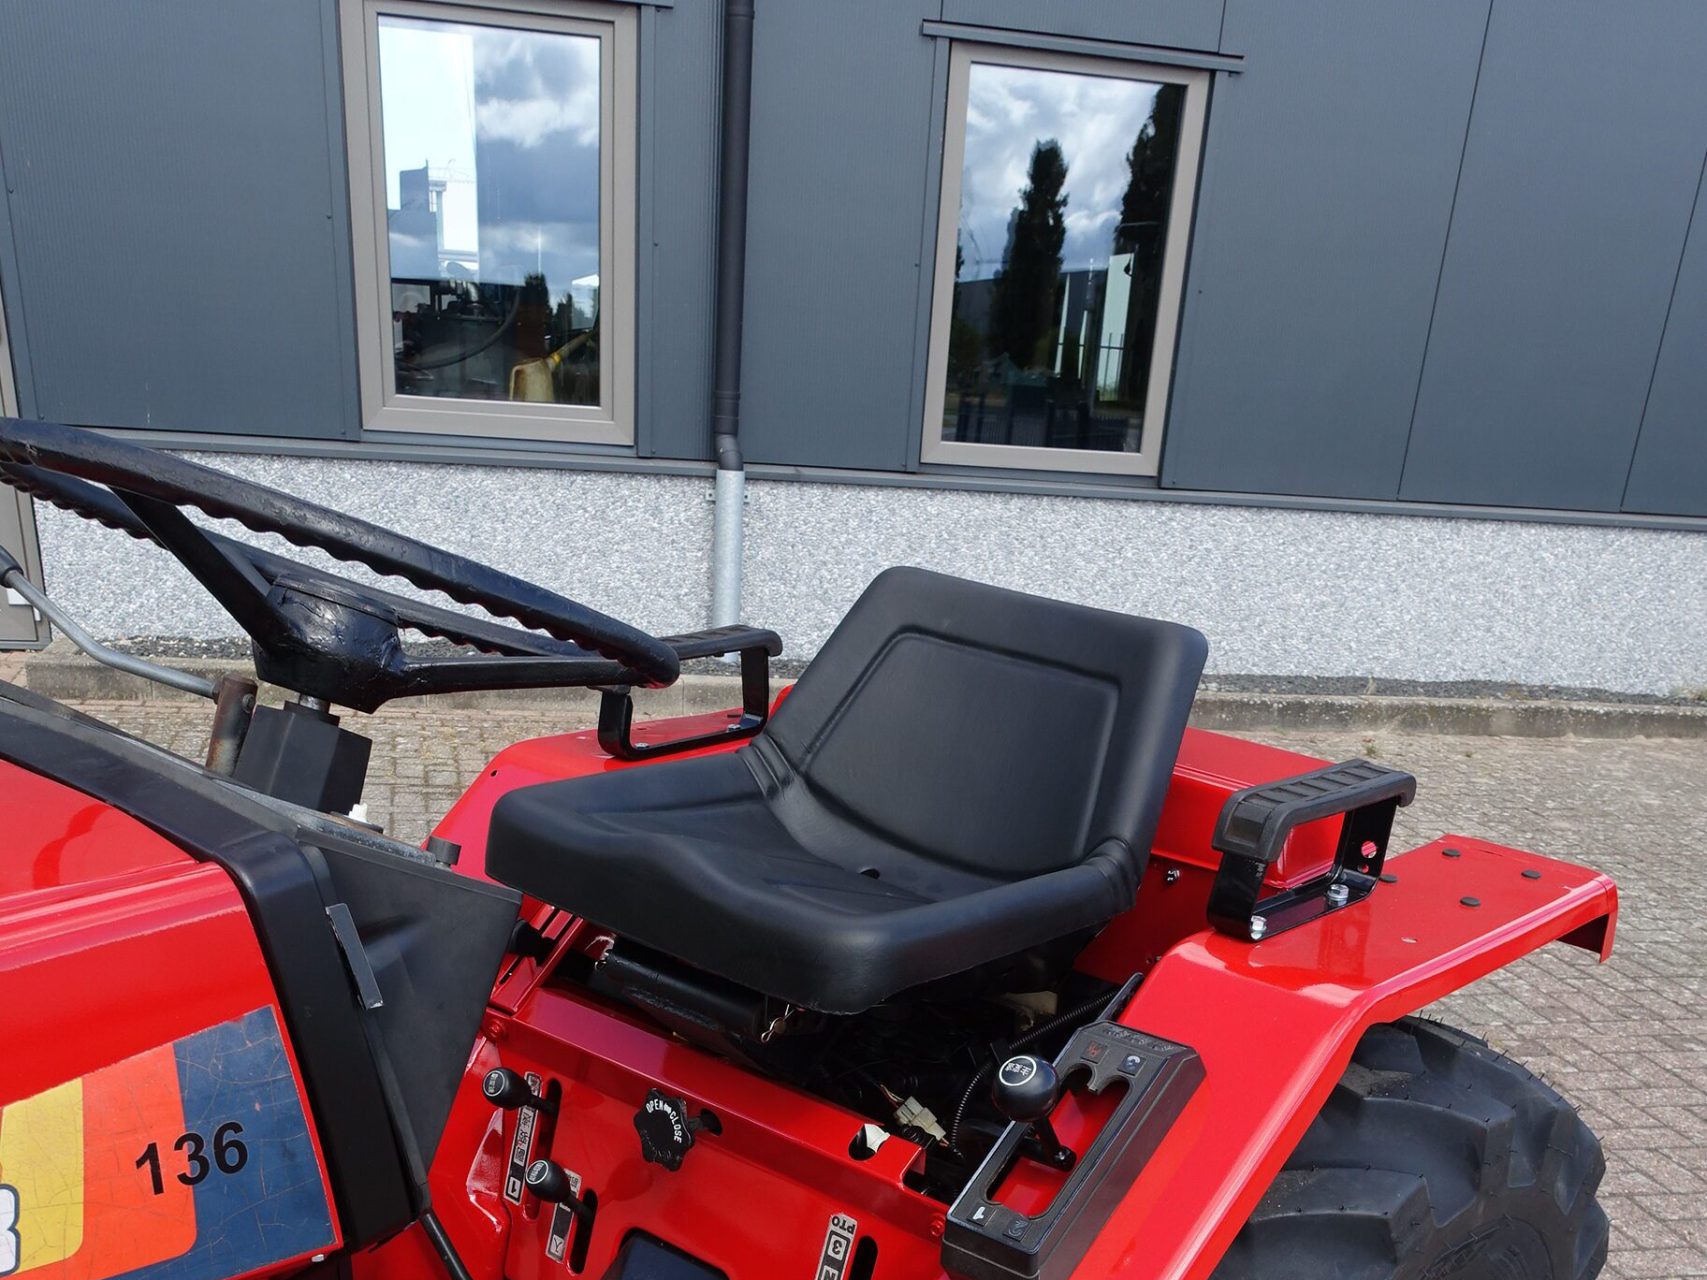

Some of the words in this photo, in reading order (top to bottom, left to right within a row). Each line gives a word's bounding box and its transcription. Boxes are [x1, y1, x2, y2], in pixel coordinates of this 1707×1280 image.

[645, 1098, 664, 1113] OPEN
[669, 1110, 682, 1144] CLOSE
[135, 1121, 249, 1196] 136
[972, 1206, 986, 1220] 1
[831, 1215, 856, 1235] PTO
[831, 1239, 844, 1255] 3
